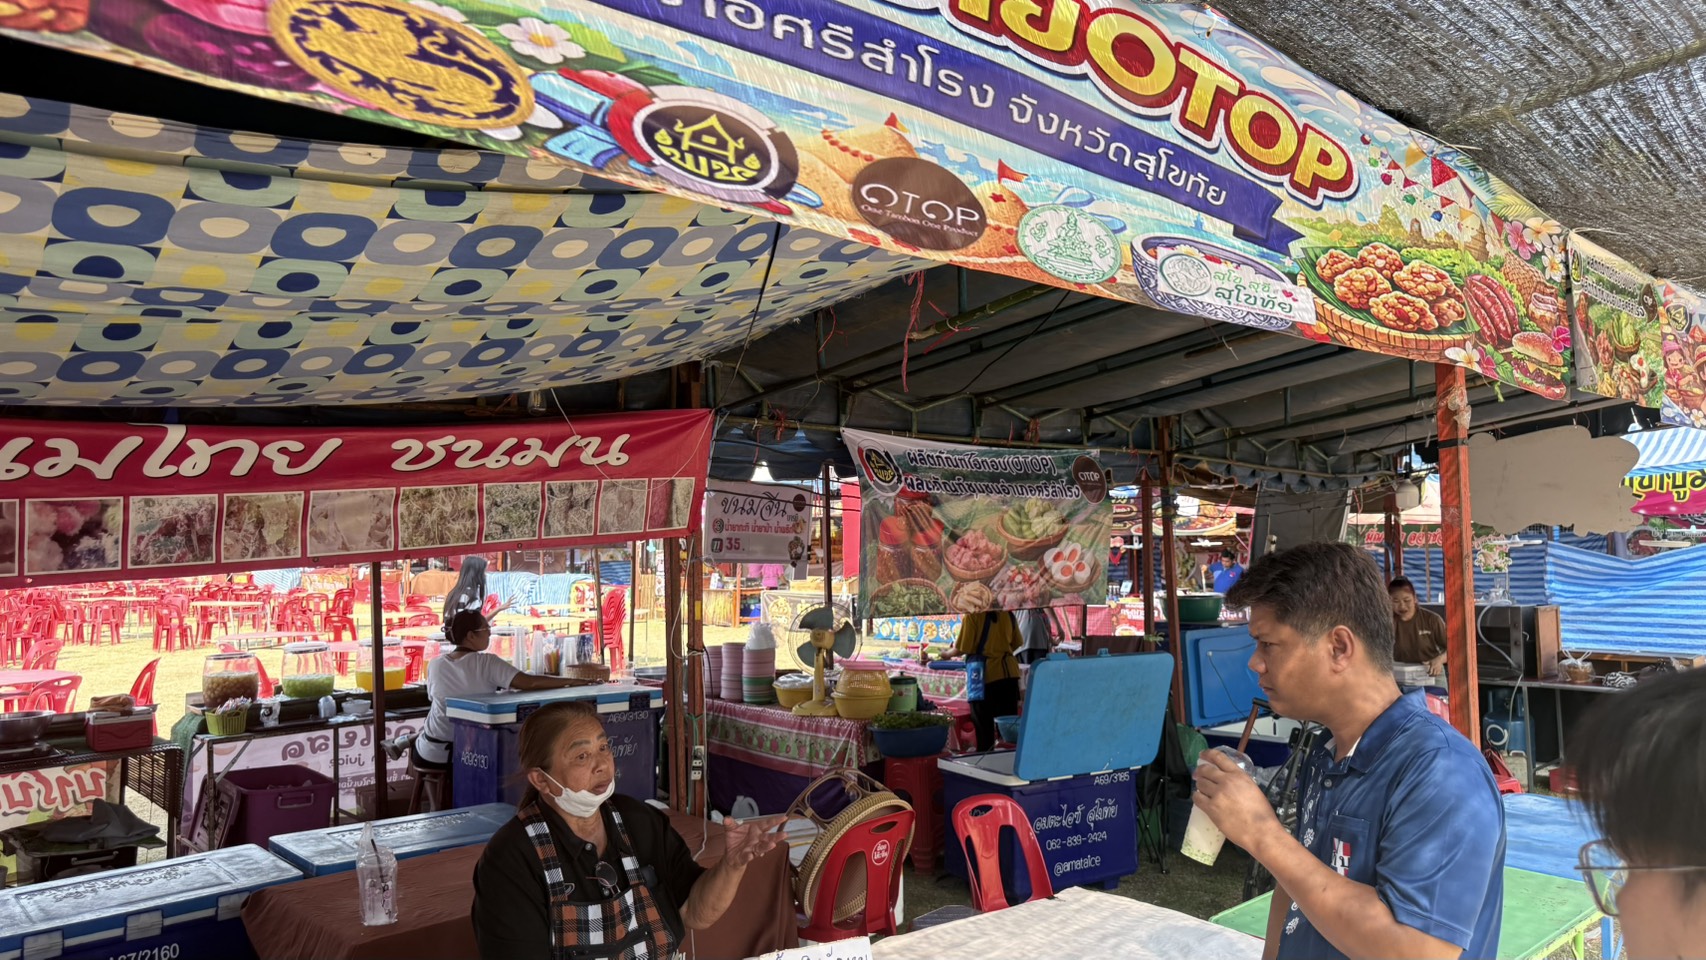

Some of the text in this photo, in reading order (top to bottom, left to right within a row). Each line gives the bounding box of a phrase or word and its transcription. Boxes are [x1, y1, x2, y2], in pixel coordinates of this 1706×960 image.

[1009, 94, 1226, 206] จังหวัดสุโขทัย
[860, 183, 979, 225] OTOP
[1215, 284, 1293, 314] สุโขทัย
[1079, 472, 1100, 481] OTOP
[721, 491, 787, 521] ขนมจีน
[607, 711, 649, 723] A69/3130
[461, 751, 489, 770] A69/3130
[1094, 771, 1130, 786] A69/3185
[1046, 831, 1107, 850] 062-839-2424
[1054, 855, 1101, 876] @amataice
